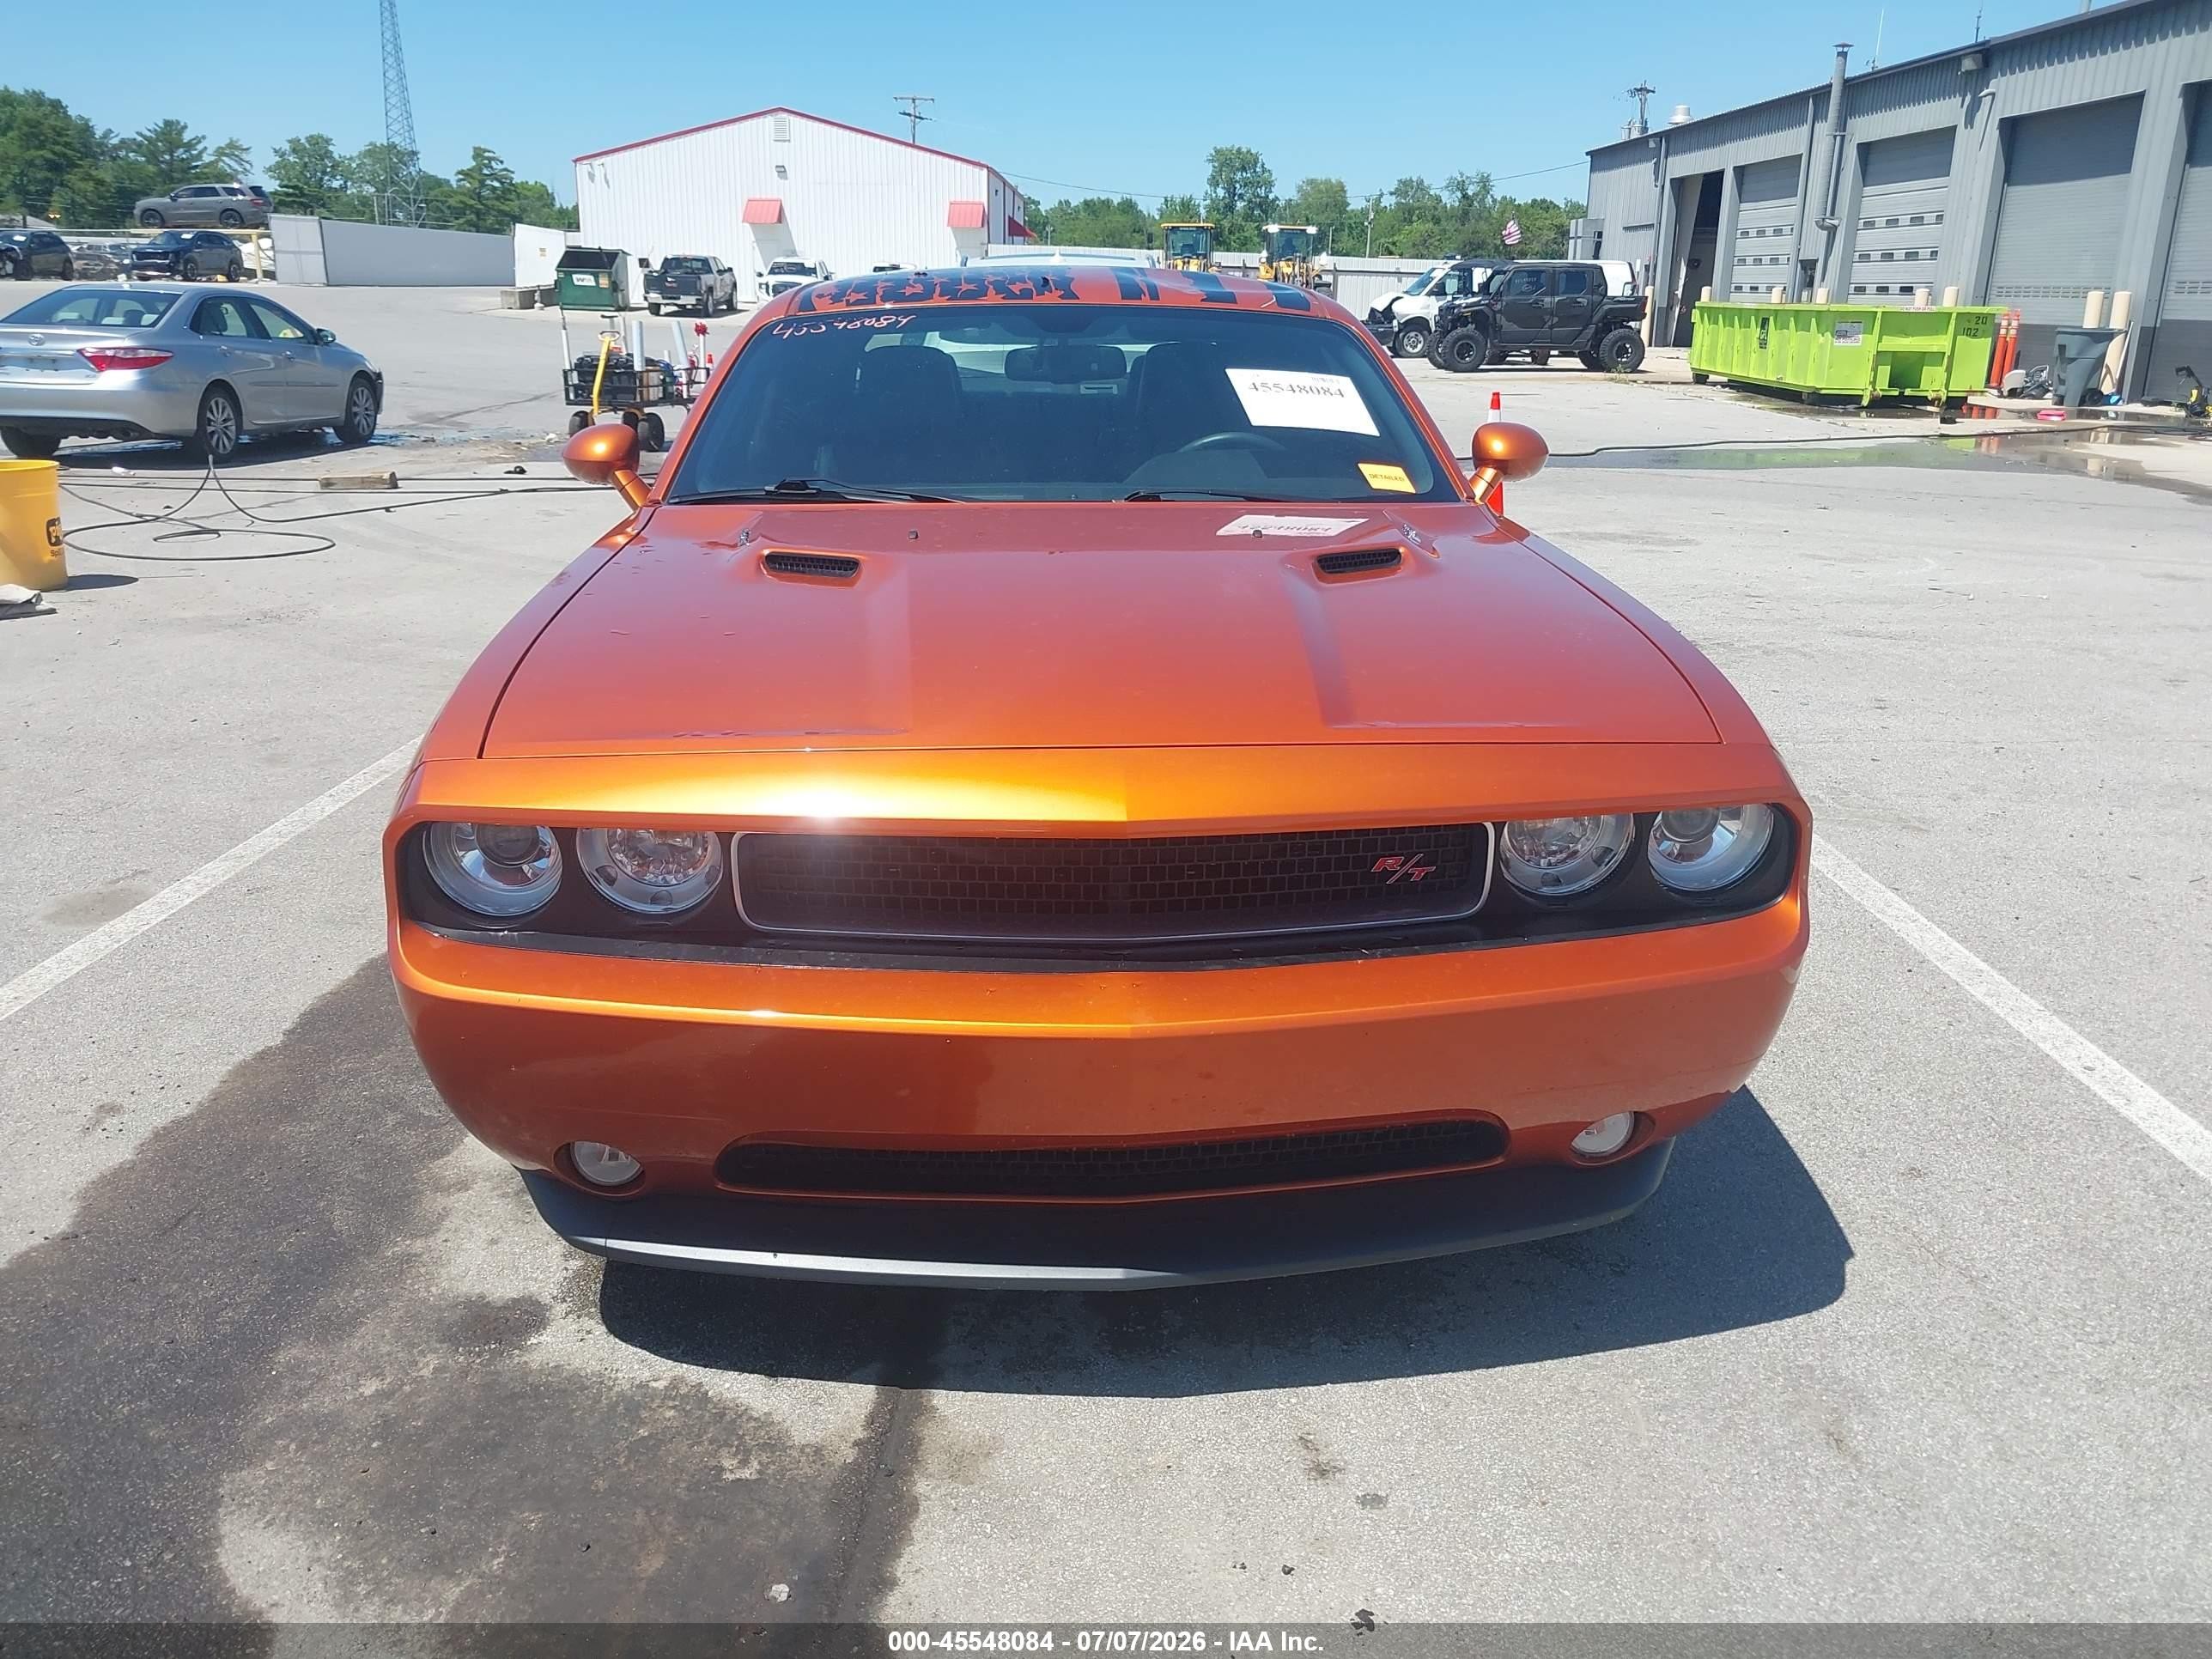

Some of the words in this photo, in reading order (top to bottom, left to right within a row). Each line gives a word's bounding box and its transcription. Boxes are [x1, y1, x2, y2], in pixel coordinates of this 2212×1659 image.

[1975, 315, 1988, 325] 20
[1962, 327, 1979, 337] 102
[1248, 381, 1346, 398] 45548084
[1370, 854, 1437, 884] R/T
